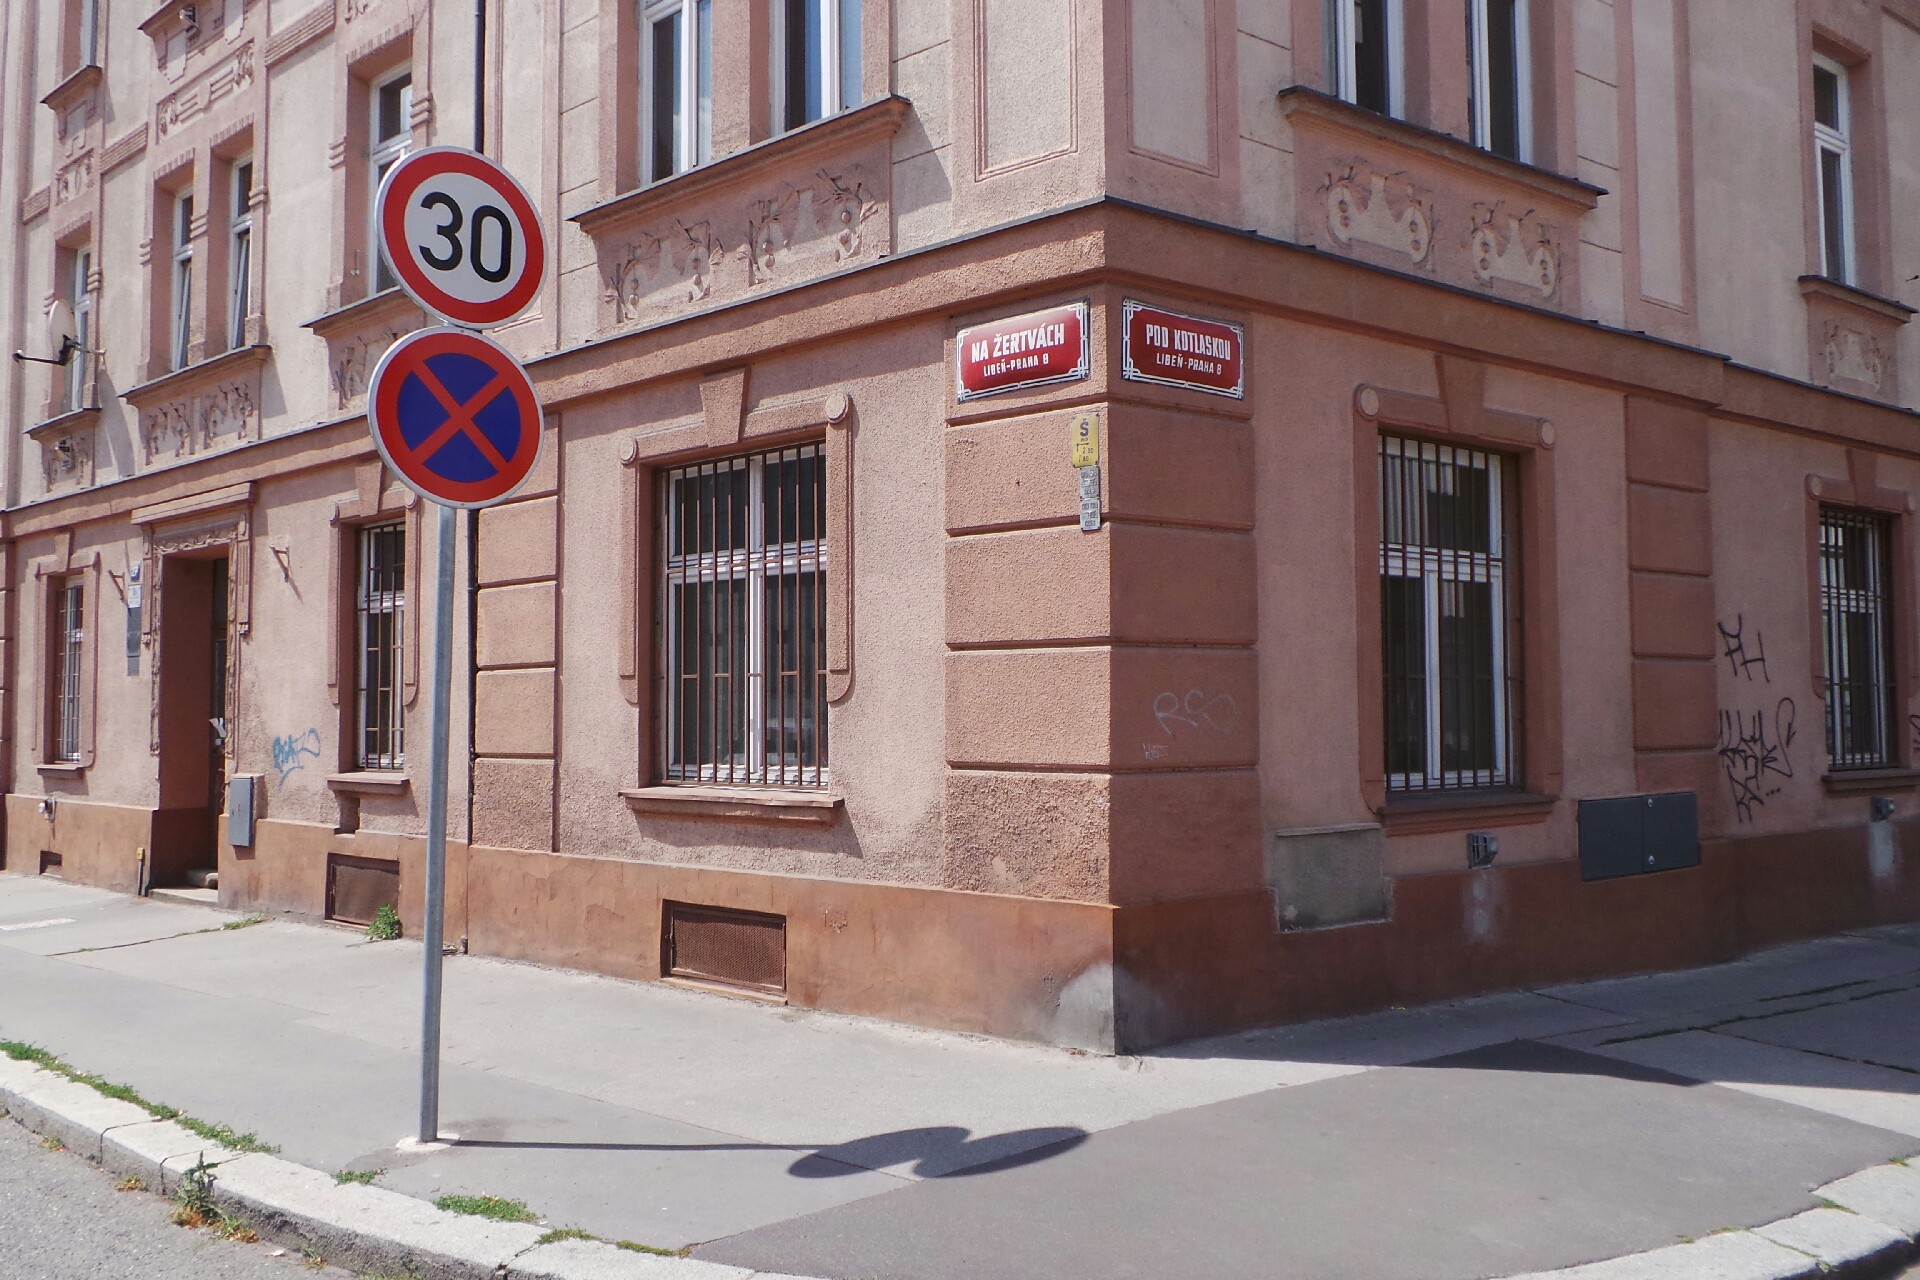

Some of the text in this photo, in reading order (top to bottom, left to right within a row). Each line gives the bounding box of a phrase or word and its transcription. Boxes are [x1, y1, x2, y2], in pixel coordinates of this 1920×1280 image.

[418, 191, 512, 283] 30
[971, 322, 1065, 363] NA ŽERTVÁCH
[1042, 352, 1049, 365] 8
[1146, 323, 1231, 361] POD KOTLASKOU
[1216, 363, 1222, 375] 8
